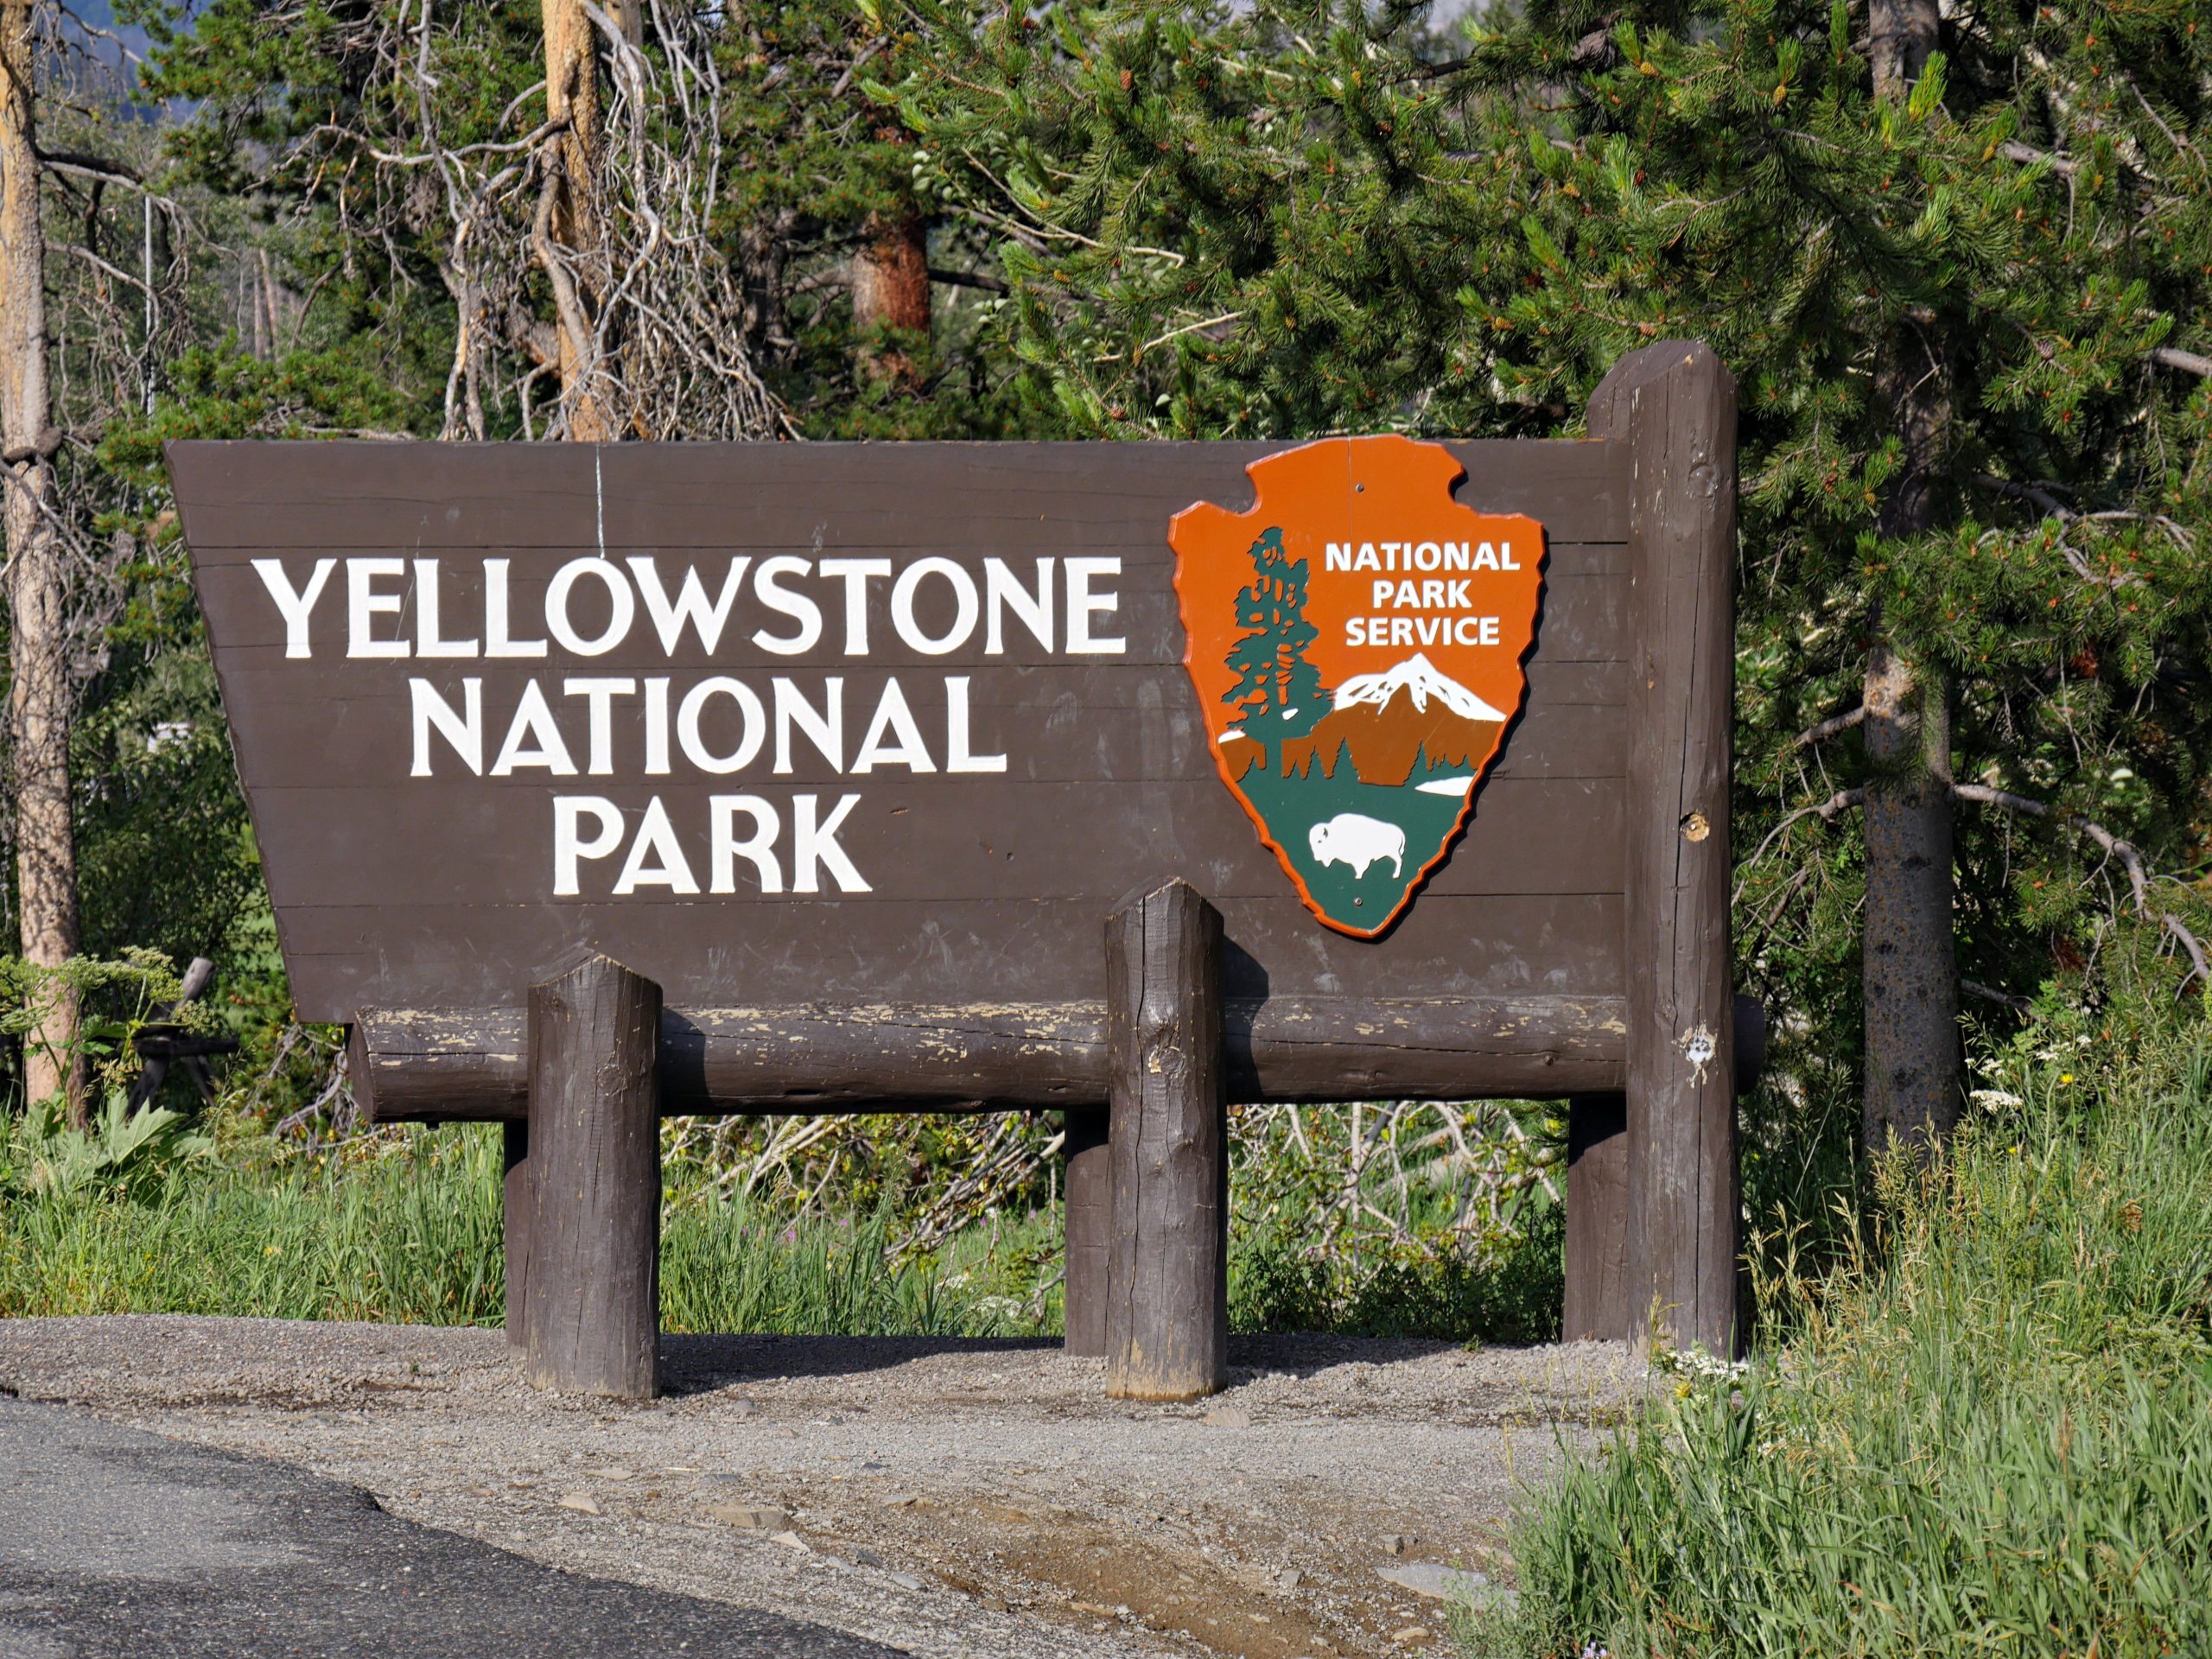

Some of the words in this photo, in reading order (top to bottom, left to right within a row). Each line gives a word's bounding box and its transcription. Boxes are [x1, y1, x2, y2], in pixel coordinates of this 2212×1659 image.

[1325, 542, 1521, 571] NATIONAL
[250, 556, 1127, 659] YELLOWSTONE
[1372, 579, 1472, 608] PARK
[1345, 616, 1500, 646] SERVICE
[408, 676, 1007, 777] NATIONAL
[552, 793, 874, 896] PARK
